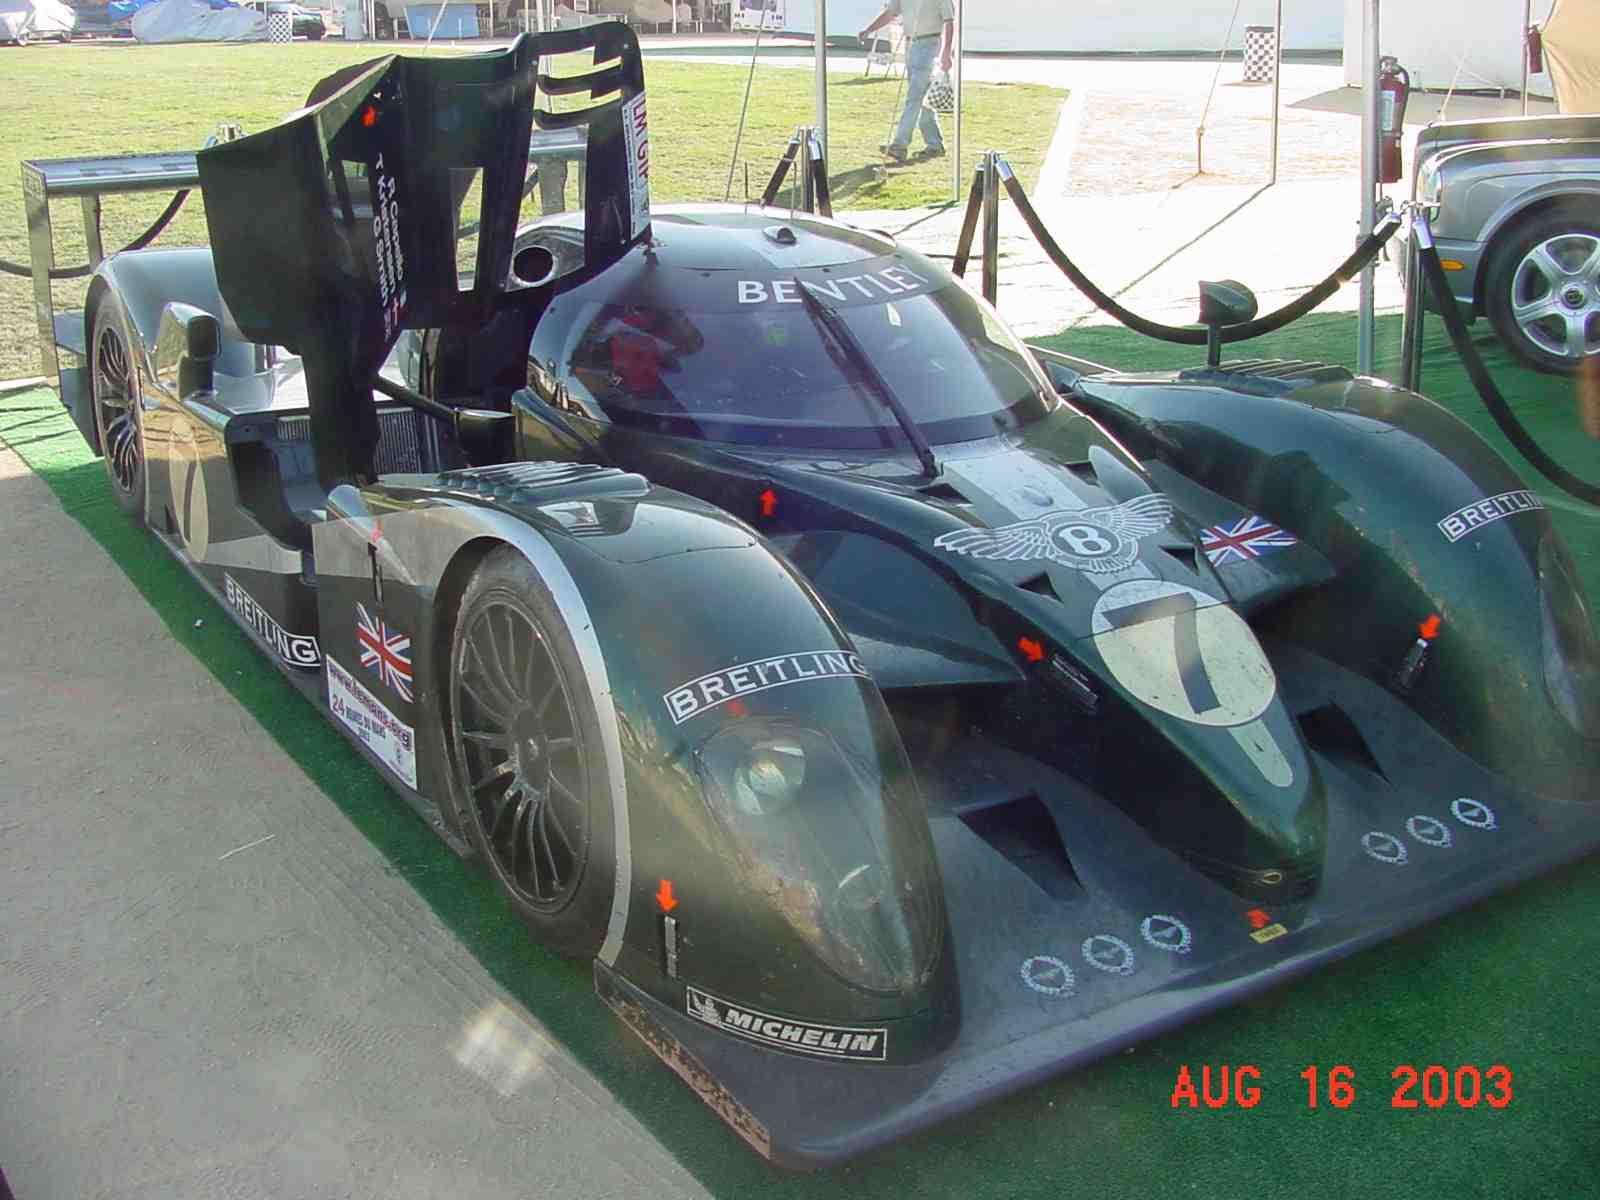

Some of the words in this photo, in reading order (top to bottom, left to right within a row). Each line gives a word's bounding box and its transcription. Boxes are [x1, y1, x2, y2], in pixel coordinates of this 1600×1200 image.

[376, 238, 388, 307] Smith
[737, 264, 928, 304] BENTLEY
[226, 579, 318, 662] BREITLING
[1101, 591, 1221, 715] 7
[332, 693, 345, 717] 24
[669, 653, 867, 719] BREITLING
[725, 1008, 879, 1052] MICHELIN
